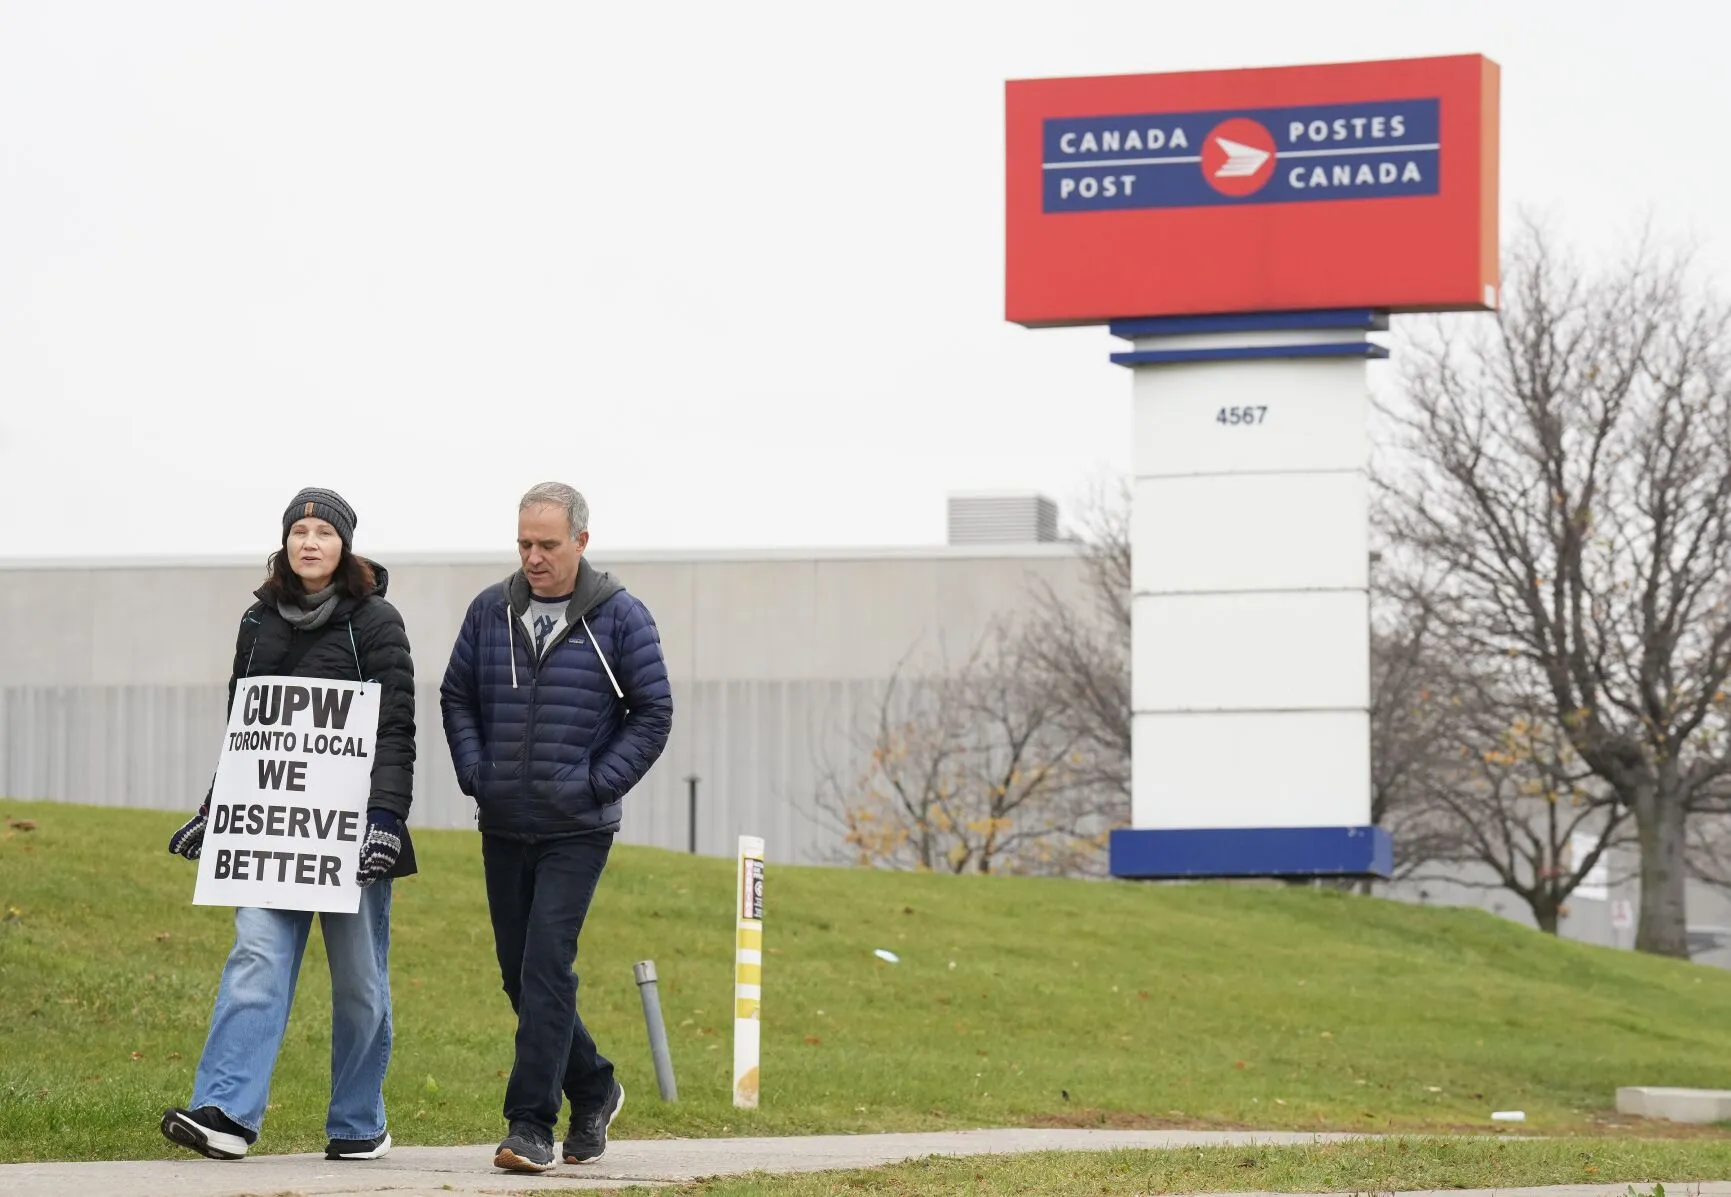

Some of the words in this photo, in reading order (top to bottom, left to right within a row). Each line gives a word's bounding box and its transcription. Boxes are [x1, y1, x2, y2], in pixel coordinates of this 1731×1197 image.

[1060, 127, 1188, 154] CANADA
[1289, 115, 1405, 143] POSTES
[1060, 175, 1136, 199] POST
[1288, 161, 1421, 189] CANADA
[1216, 406, 1268, 426] 4567
[243, 684, 355, 730] CUPW
[228, 730, 297, 752] TORONTO
[302, 733, 368, 758] LOCAL
[258, 759, 308, 792] WE
[212, 804, 359, 842] DESERVE
[214, 849, 342, 887] BETTER
